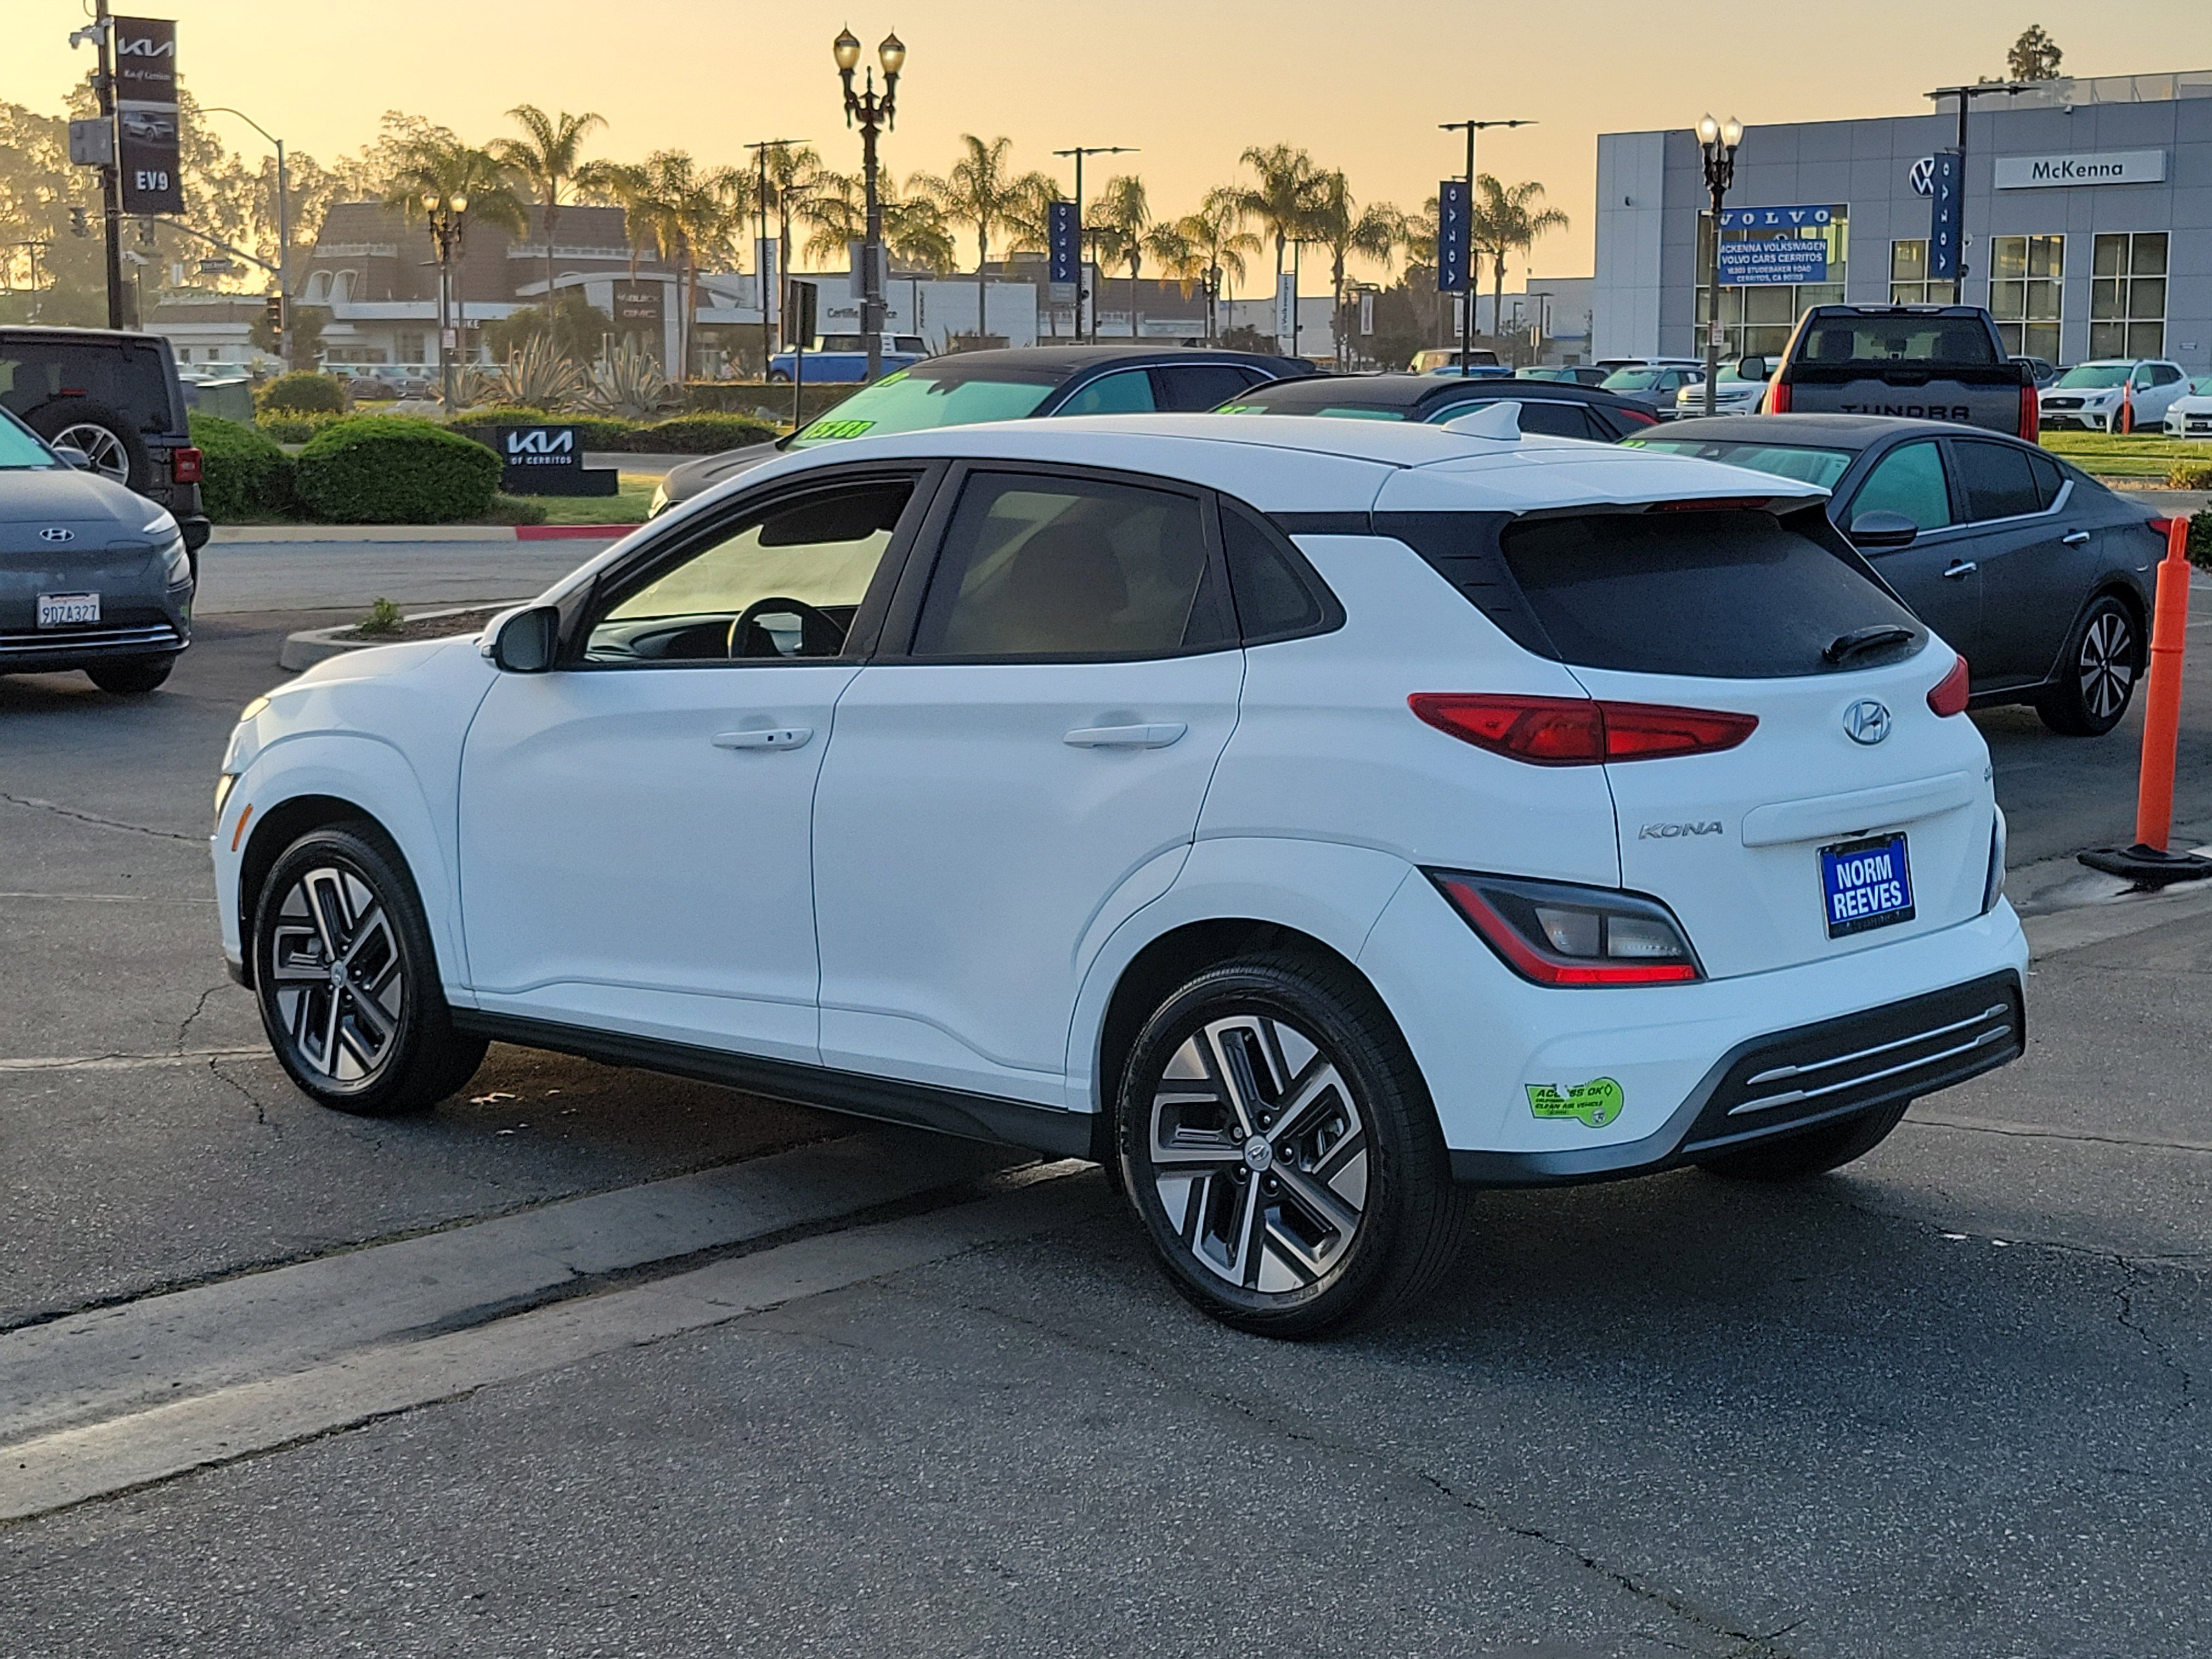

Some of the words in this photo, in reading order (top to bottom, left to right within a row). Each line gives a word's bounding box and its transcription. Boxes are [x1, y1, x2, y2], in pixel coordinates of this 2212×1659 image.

[118, 37, 174, 58] KIA
[2032, 160, 2123, 180] McKenna
[137, 171, 168, 191] EV9
[1720, 210, 1829, 226] VOLVO
[1939, 162, 1950, 270] VOLVO
[1448, 187, 1457, 285] VOLVO
[1763, 241, 1826, 252] VOLKSWAGEN
[1722, 255, 1750, 264] VOLVO
[1752, 254, 1776, 263] CARS
[1778, 253, 1823, 263] CERRITOS
[1841, 405, 1970, 420] TUNDRA
[509, 431, 573, 453] KIA
[511, 456, 523, 465] OF
[526, 455, 572, 465] CERRITOS
[1638, 821, 1723, 840] KONA
[1836, 854, 1893, 890] NORM
[1833, 880, 1903, 919] REEVES
[1537, 1088, 1584, 1098] ACSS
[1588, 1085, 1604, 1096] OK
